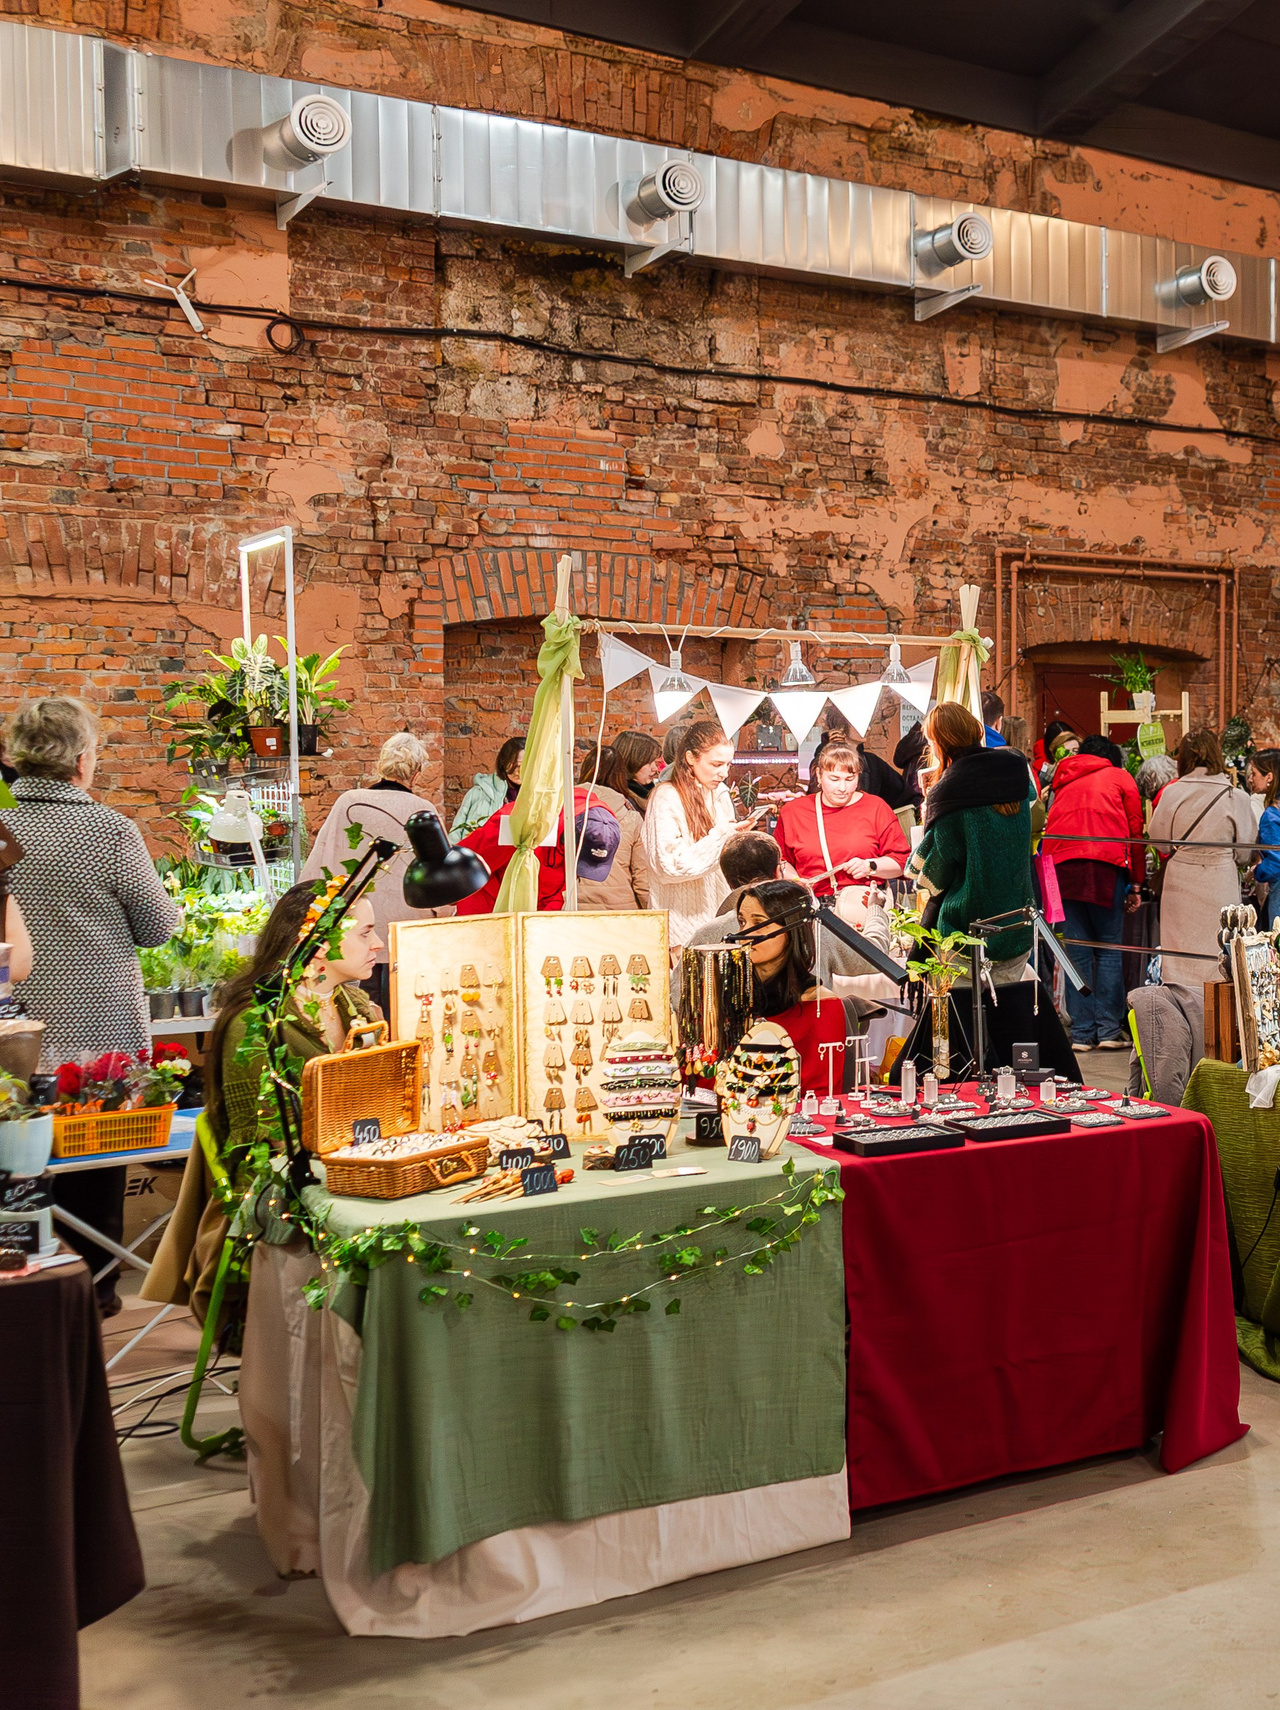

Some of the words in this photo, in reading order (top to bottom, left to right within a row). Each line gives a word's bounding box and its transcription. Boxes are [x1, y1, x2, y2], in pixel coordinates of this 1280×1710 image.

[354, 1125, 380, 1143] 450
[619, 1145, 650, 1170] 250
[730, 1139, 759, 1160] 1900
[502, 1155, 532, 1169] 400
